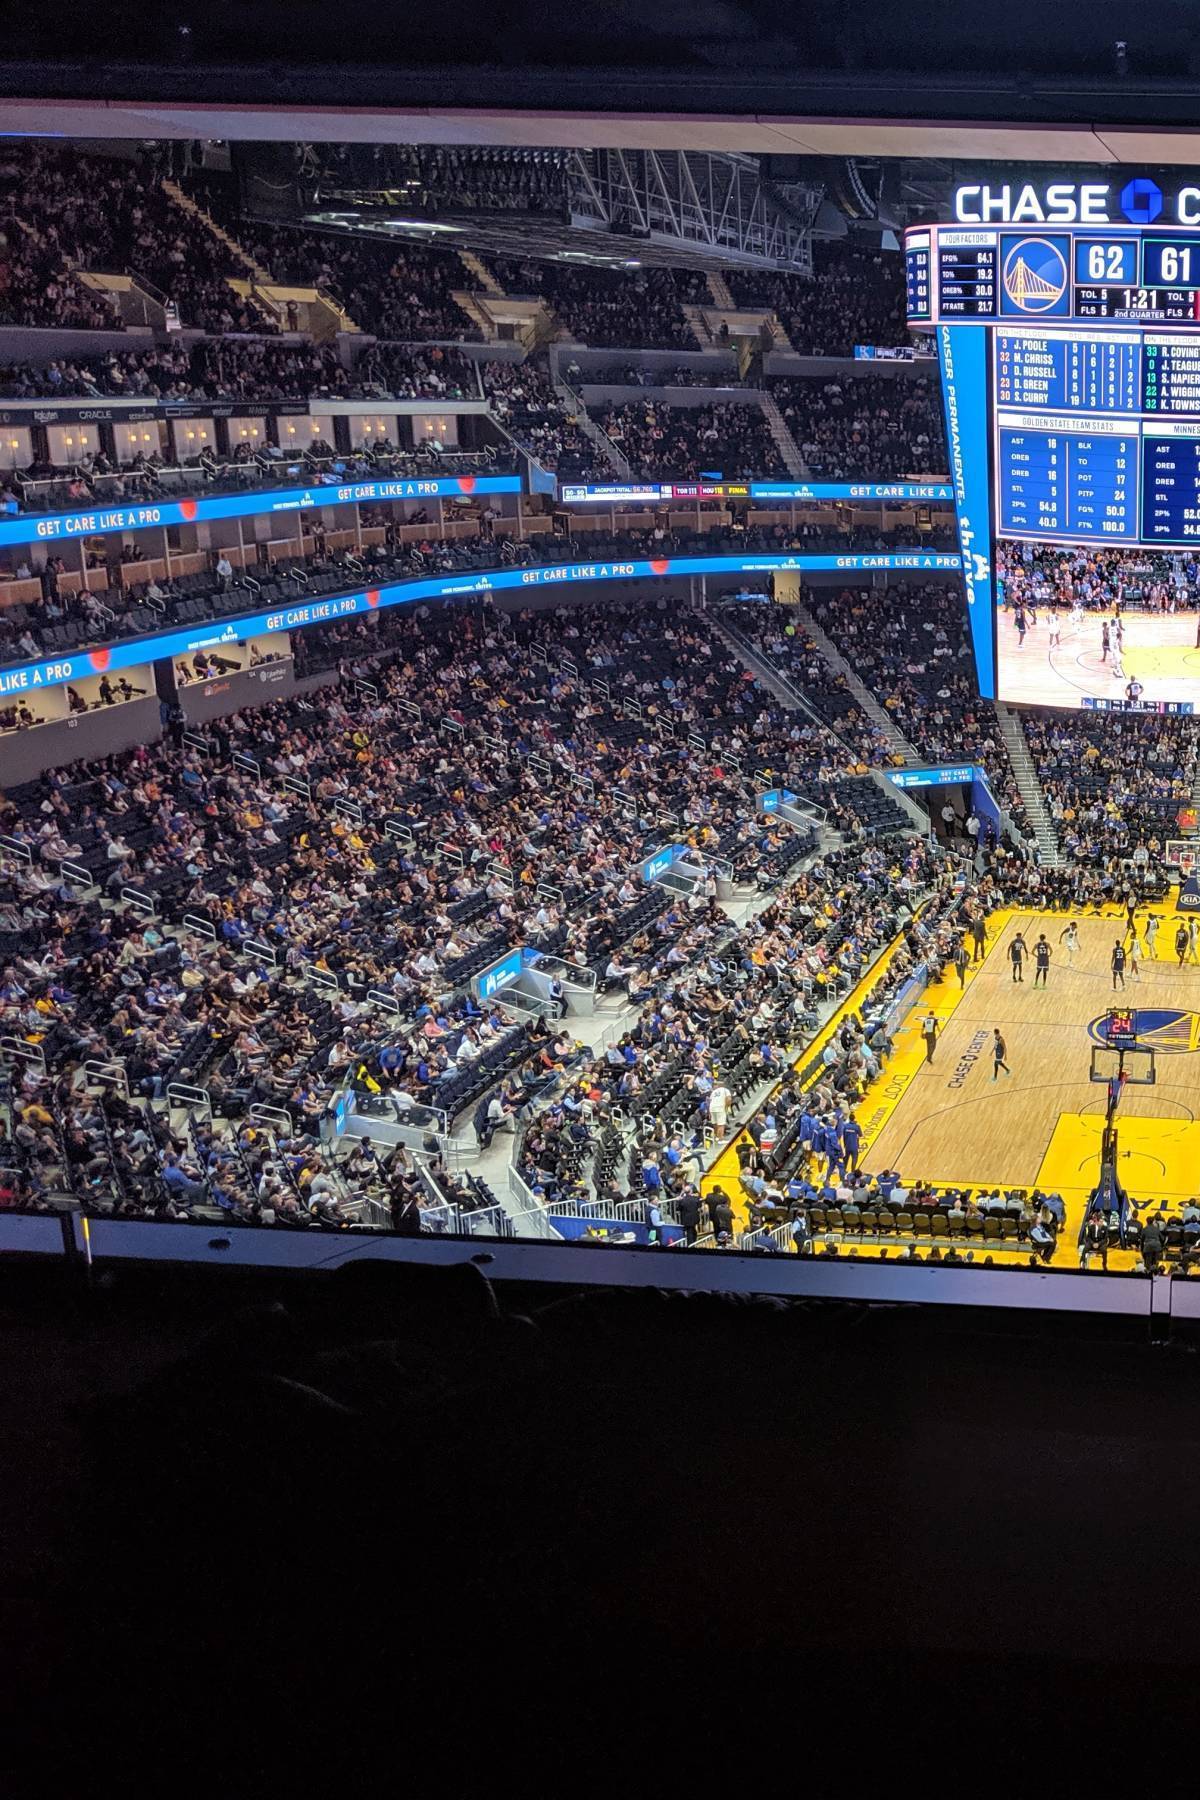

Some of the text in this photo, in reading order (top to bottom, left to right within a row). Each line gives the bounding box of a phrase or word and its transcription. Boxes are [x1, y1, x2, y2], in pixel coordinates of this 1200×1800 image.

[956, 185, 1110, 222] CHASE
[946, 235, 988, 243] FOUR FACTORS
[978, 253, 992, 263] 64.1
[1089, 246, 1124, 280] 62
[1161, 247, 1190, 281] 61
[977, 269, 992, 279] 19.2
[976, 285, 992, 295] 30.0
[1081, 289, 1107, 300] TOL 5
[1124, 290, 1157, 309] 1:21
[1168, 291, 1194, 302] TOL 5
[978, 301, 992, 311] 21.7
[1081, 305, 1107, 316] FLS 5
[1130, 311, 1165, 319] QUARTER
[1167, 307, 1194, 319] FLS 4
[1002, 339, 1047, 351] 3 J. POOLE
[1146, 346, 1157, 356] 33
[1162, 347, 1169, 357] R.
[1000, 352, 1053, 364] 32 M. CHRISS
[1149, 360, 1154, 369] 0
[1162, 361, 1169, 370] J.
[1003, 365, 1056, 378] 0 D. RUSSELL
[1000, 378, 1048, 390] 23 D. GREEN
[1147, 373, 1200, 384] 13 S. NAPIER
[1000, 391, 1048, 403] 30 S. CURRY
[1146, 386, 1157, 396] 22
[1161, 387, 1169, 396] A.
[1146, 399, 1200, 410] 32 K. TOWNS
[79, 410, 112, 420] ORACLE
[338, 483, 438, 500] GET CARE LIKE A PRO
[850, 487, 946, 496] GET CARE LIKE A
[37, 509, 160, 535] GET CARE LIKE A PRO
[837, 558, 959, 566] GET CARE LIKE A PRO
[960, 517, 976, 604] thrive
[523, 565, 634, 582] GET CARE LIKE A PRO
[267, 600, 356, 629] GET CARE LIKE A PRO
[0, 663, 72, 691] LIKE A PRO
[1112, 1020, 1130, 1032] 24
[948, 1030, 991, 1088] CHASE CENTER
